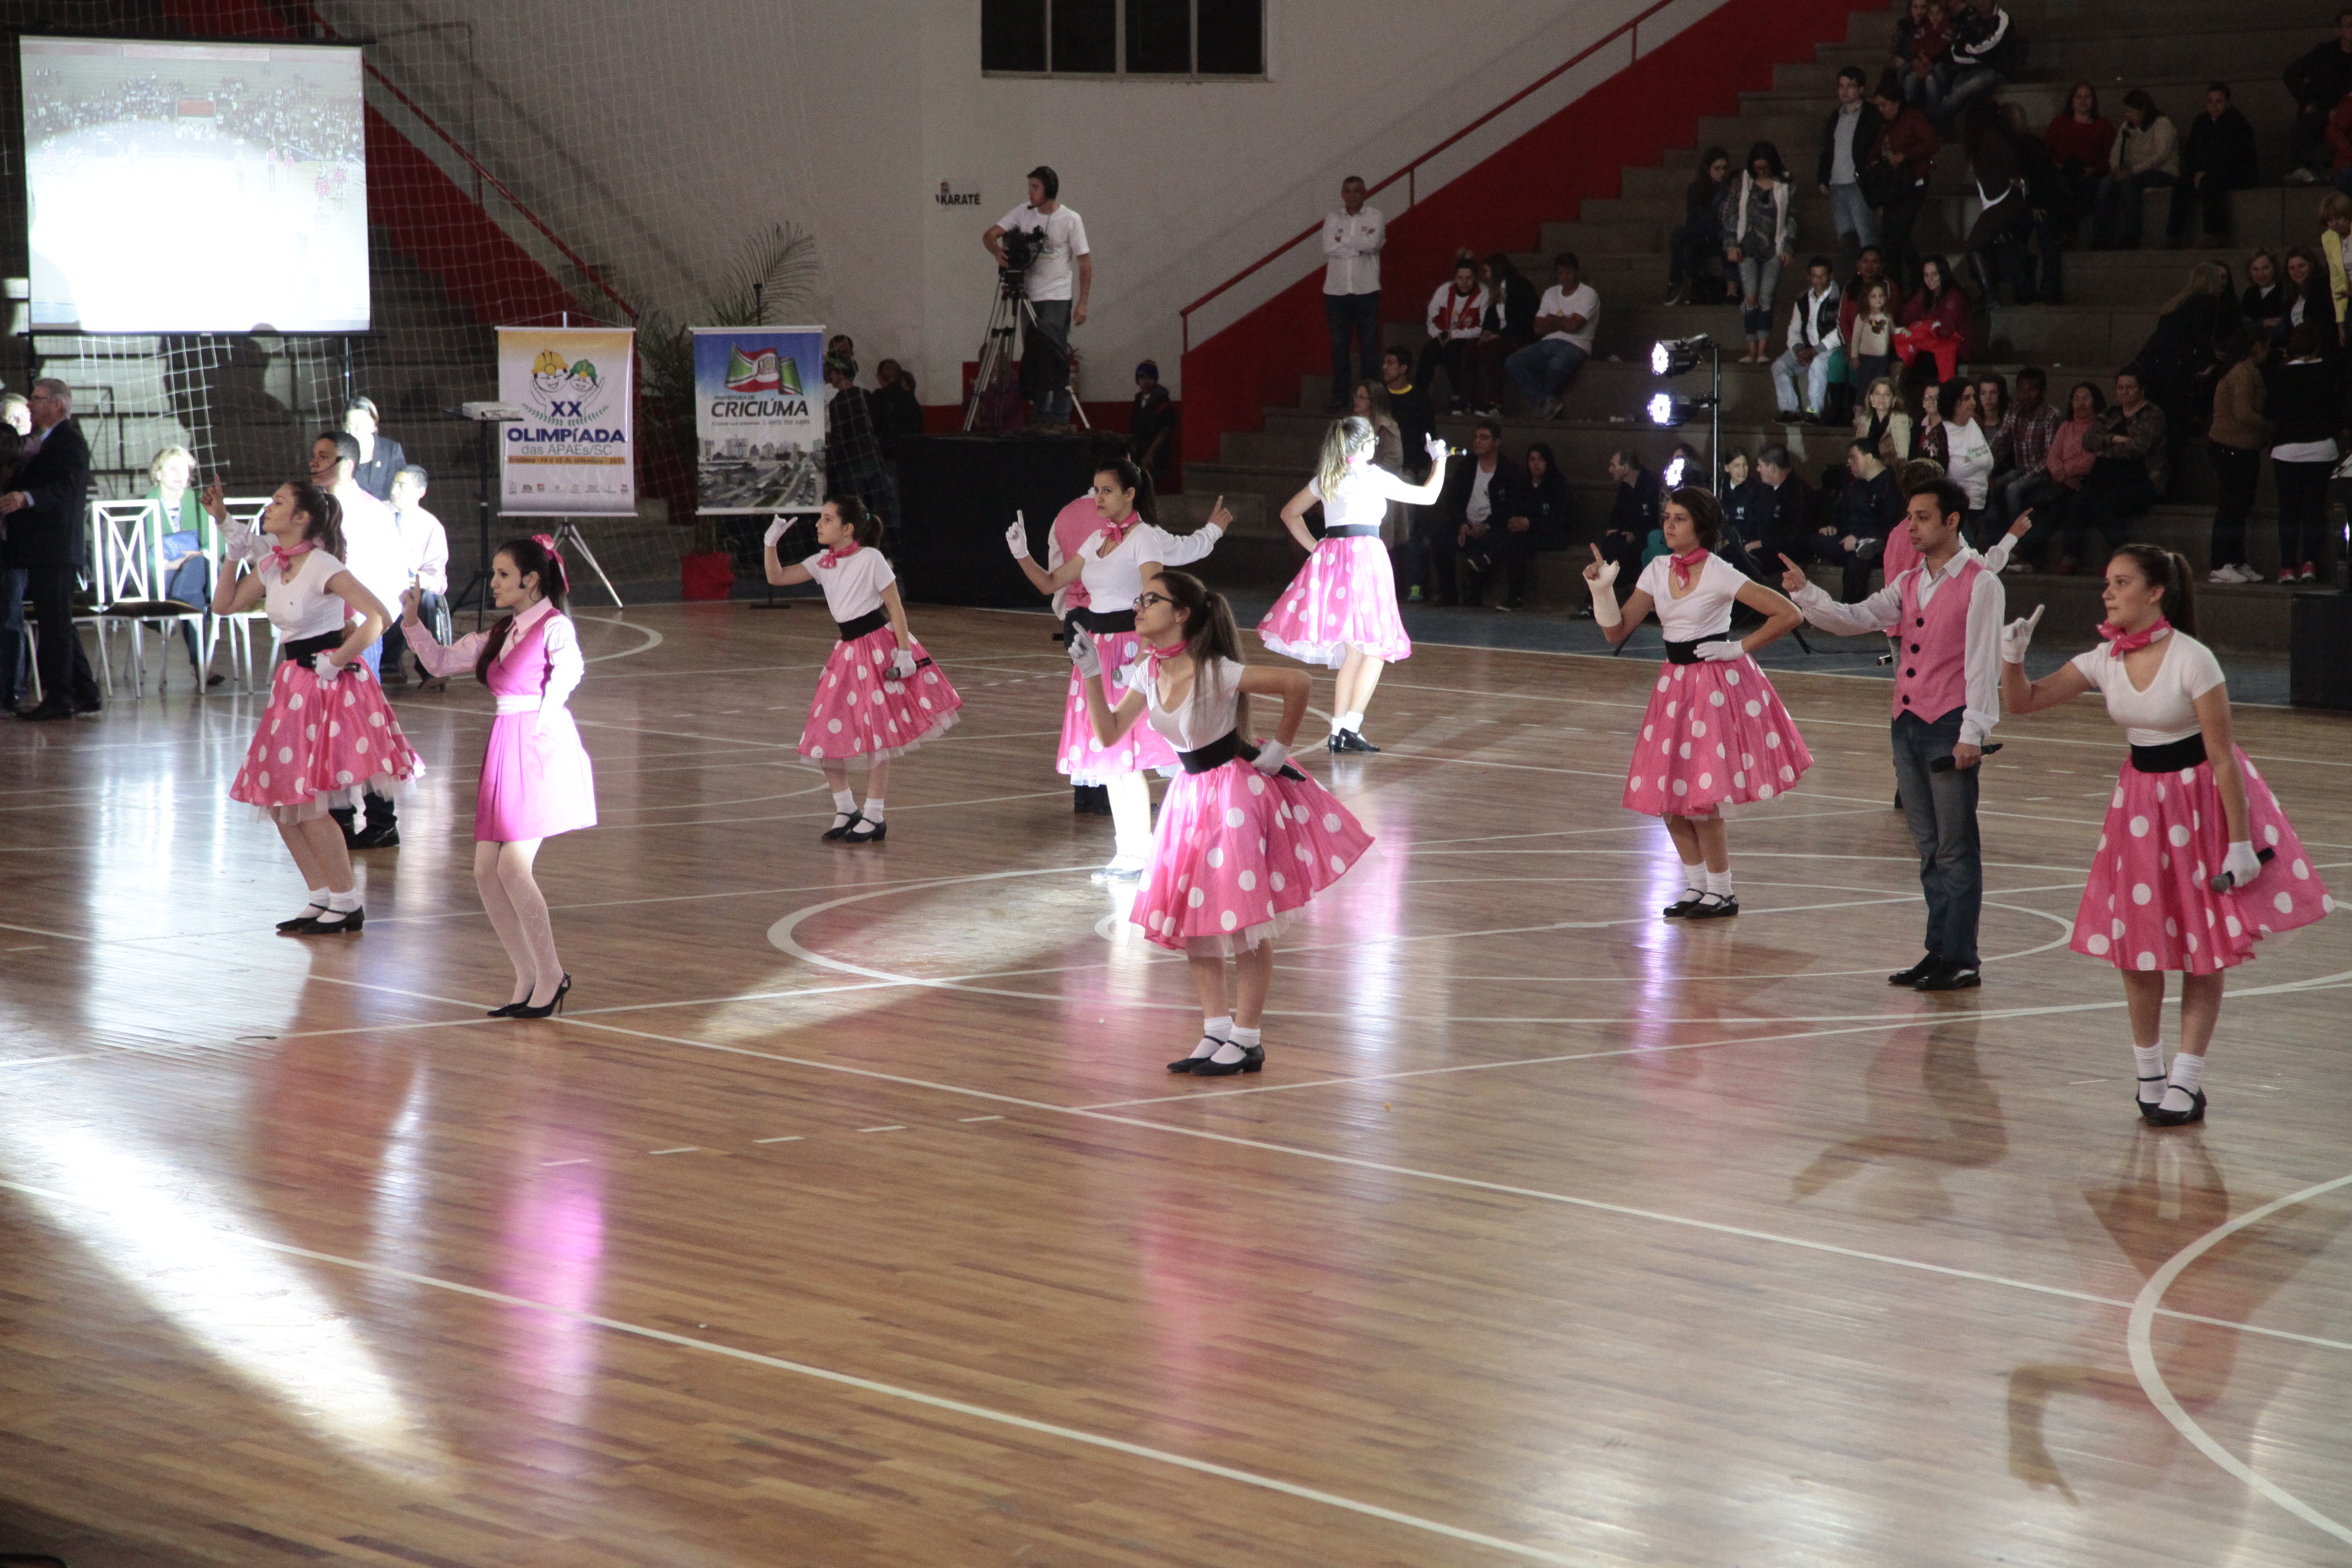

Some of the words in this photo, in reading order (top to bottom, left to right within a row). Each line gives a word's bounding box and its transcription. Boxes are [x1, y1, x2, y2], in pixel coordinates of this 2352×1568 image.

[551, 400, 583, 417] XX
[711, 398, 808, 417] CRICIÚMA
[521, 444, 543, 455] das
[547, 444, 612, 456] APAEs/SC
